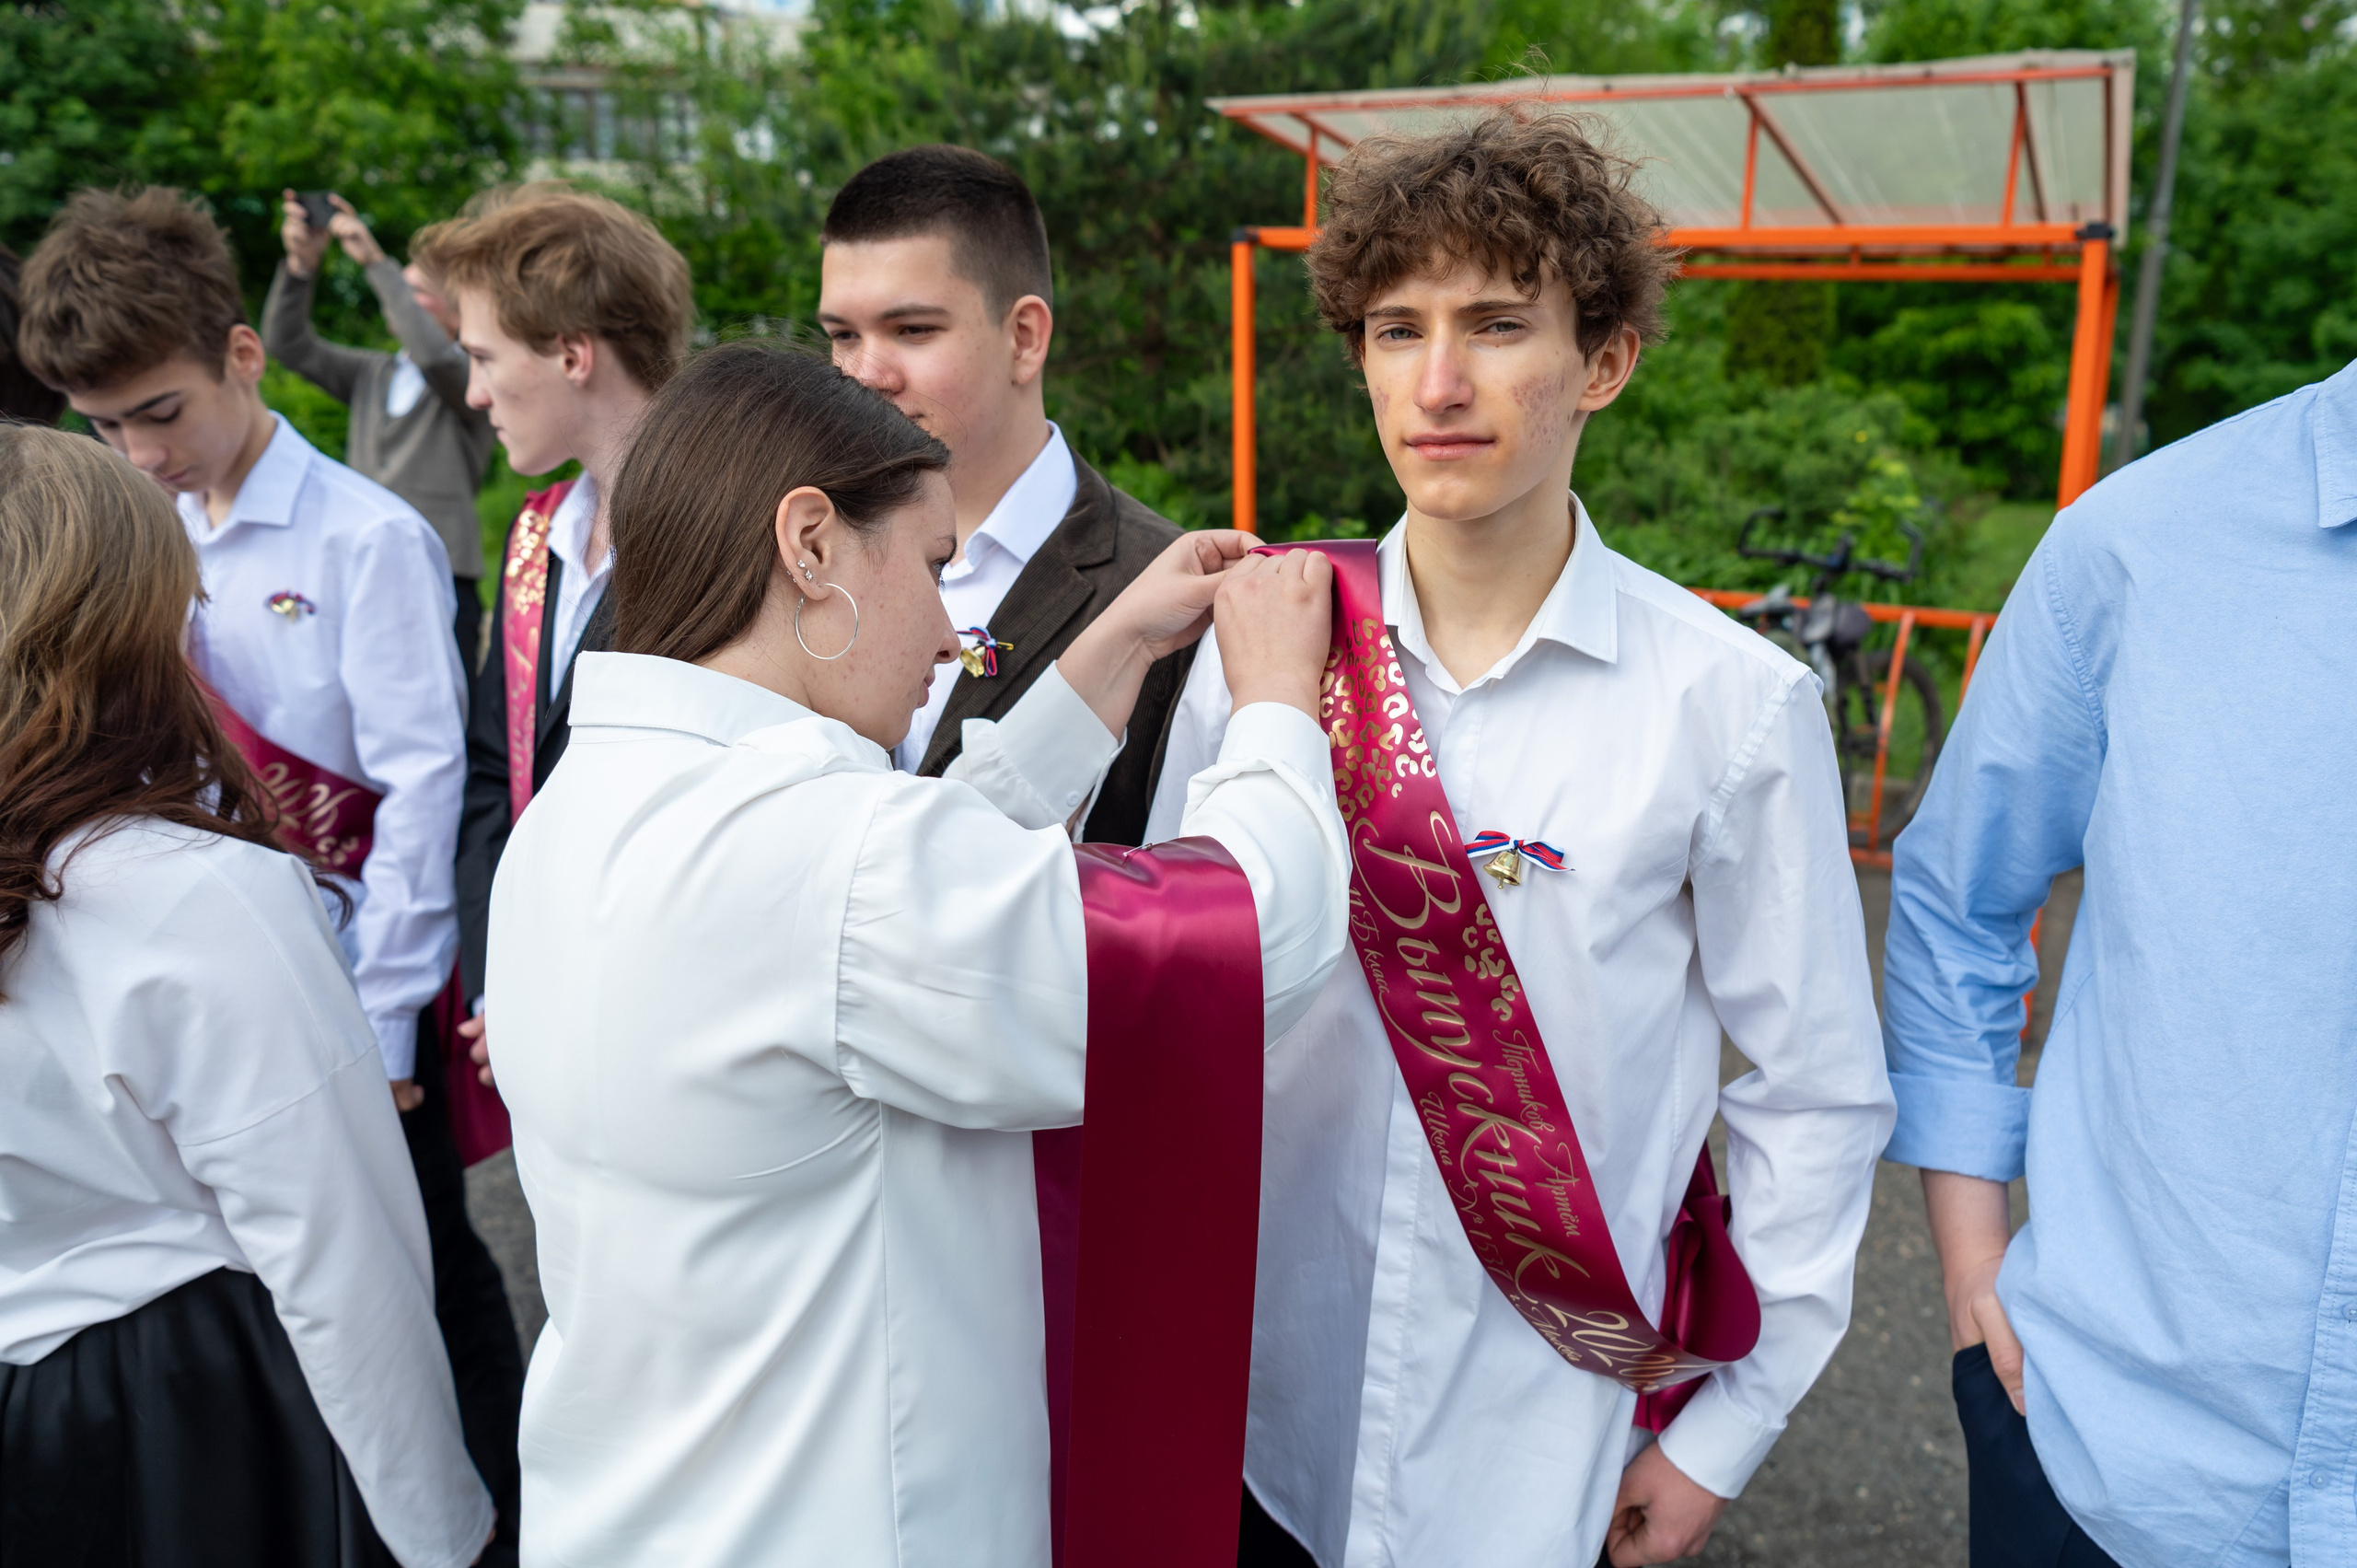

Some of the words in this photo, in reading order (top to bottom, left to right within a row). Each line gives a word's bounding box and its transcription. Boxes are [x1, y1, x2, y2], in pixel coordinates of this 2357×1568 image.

[1349, 910, 1380, 942] Б
[1364, 947, 1390, 994] класс
[1352, 810, 1590, 1304] Выпускник
[1545, 1303, 1720, 1377] 2026
[1492, 1029, 1555, 1132] Терников
[1533, 1142, 1581, 1237] Артём
[1419, 1092, 1453, 1166] Школа
[1448, 1179, 1484, 1224] №
[1469, 1229, 1514, 1282] 1537
[1515, 1305, 1583, 1362] Москва
